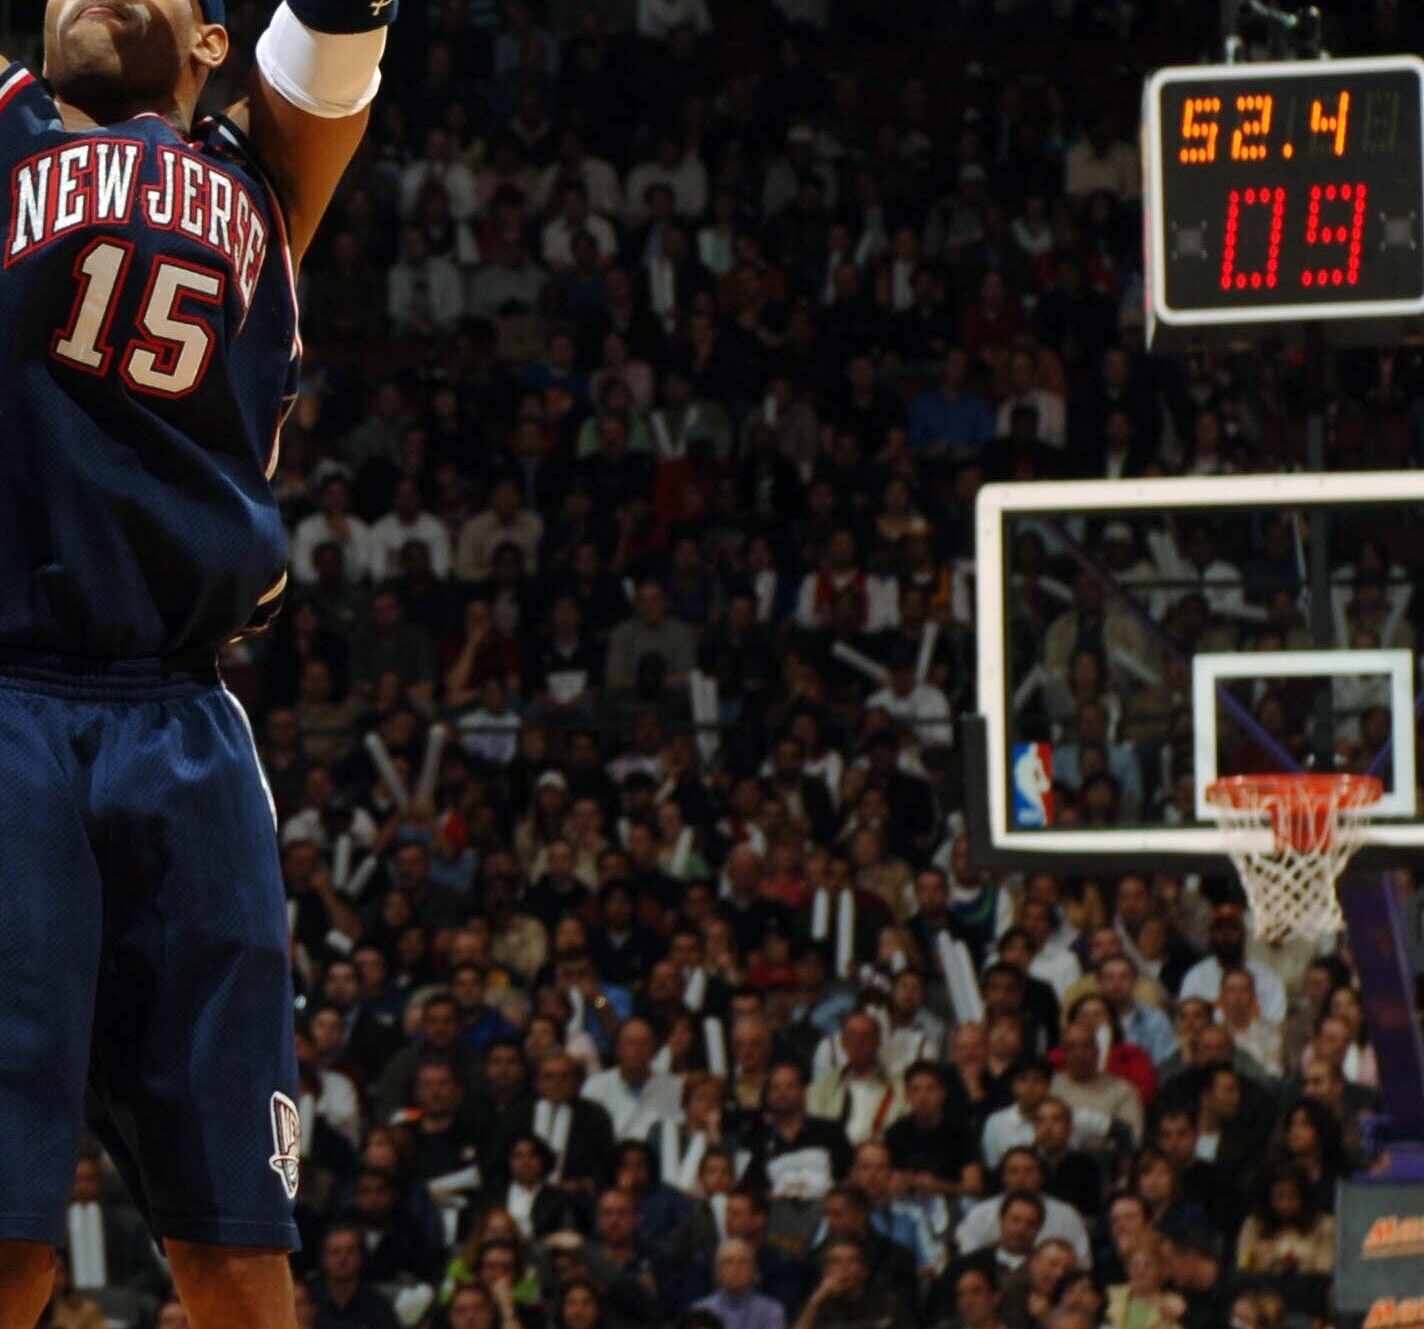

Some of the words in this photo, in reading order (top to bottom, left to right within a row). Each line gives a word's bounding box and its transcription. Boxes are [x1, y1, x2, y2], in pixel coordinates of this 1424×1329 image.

[1179, 90, 1351, 165] 52.4
[6, 138, 143, 263] NEW
[143, 140, 268, 315] JERSE
[1220, 181, 1368, 291] 09
[50, 236, 225, 398] 15
